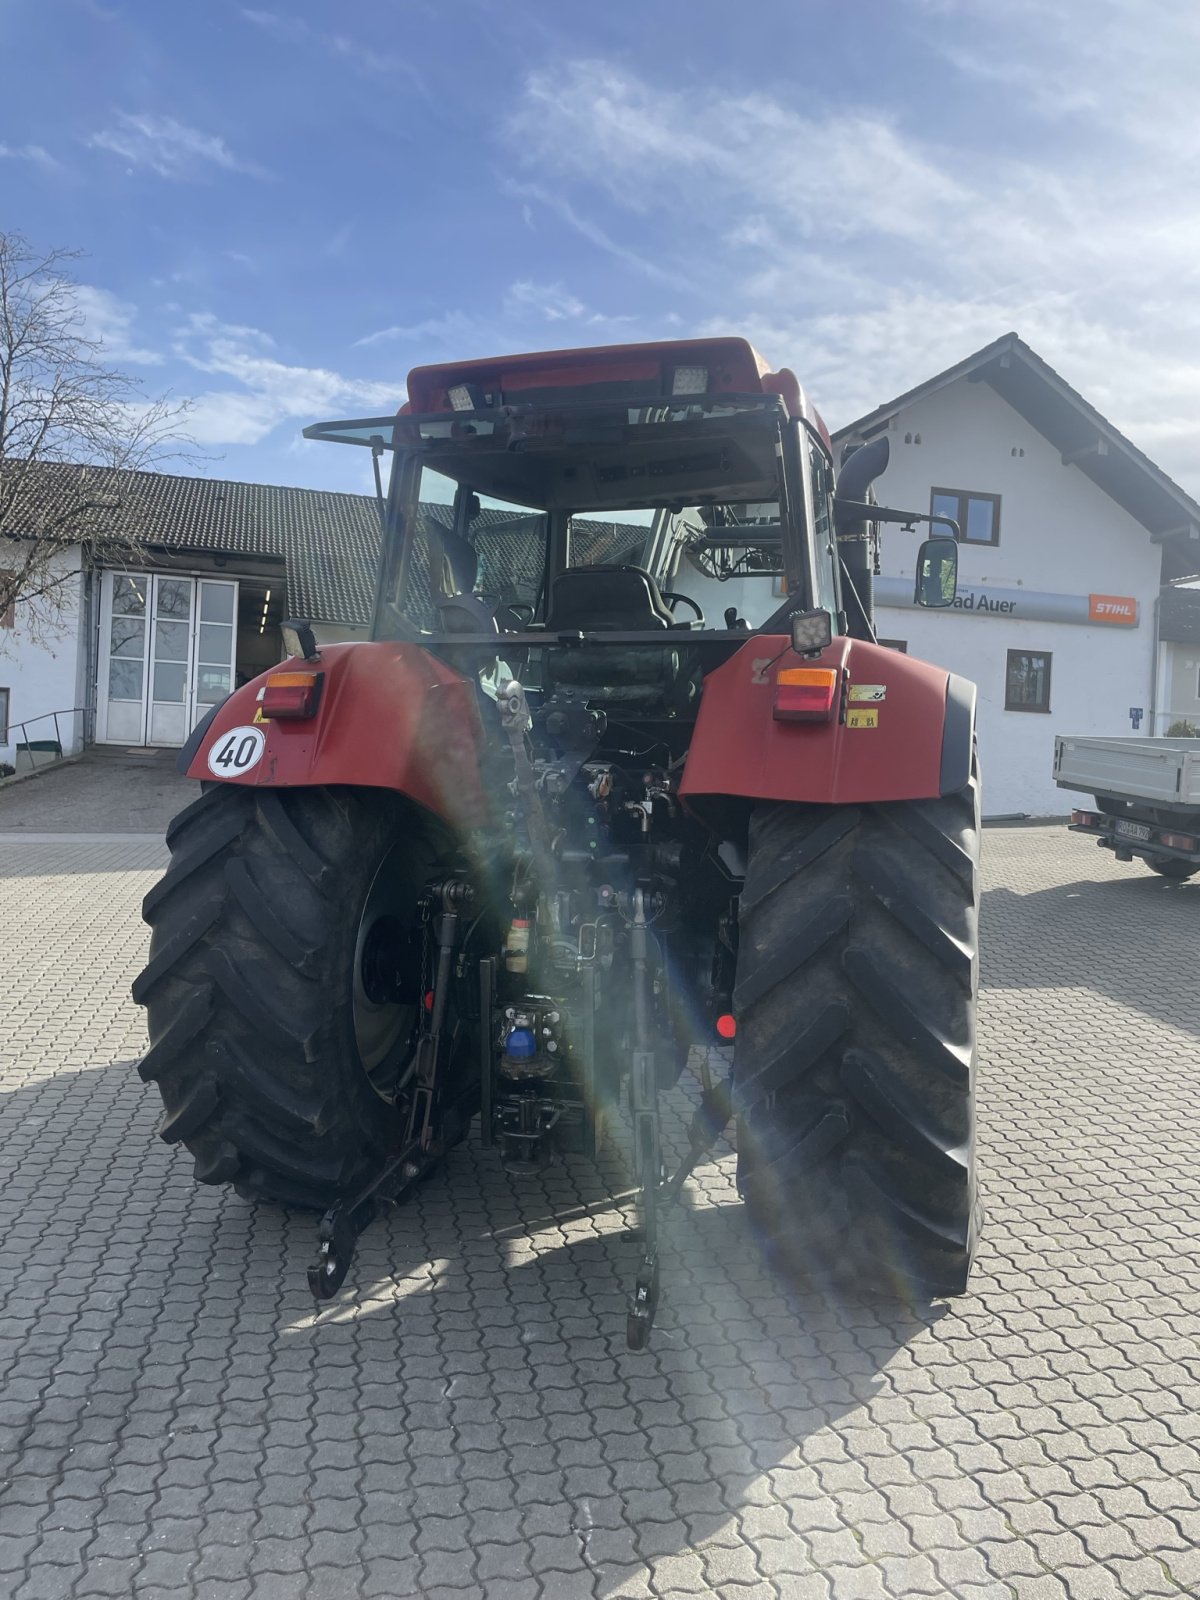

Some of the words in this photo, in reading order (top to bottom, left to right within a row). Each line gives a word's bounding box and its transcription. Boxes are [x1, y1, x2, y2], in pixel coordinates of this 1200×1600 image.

[976, 594, 1016, 613] Auer
[1095, 603, 1132, 615] STIHL
[216, 736, 257, 768] 40
